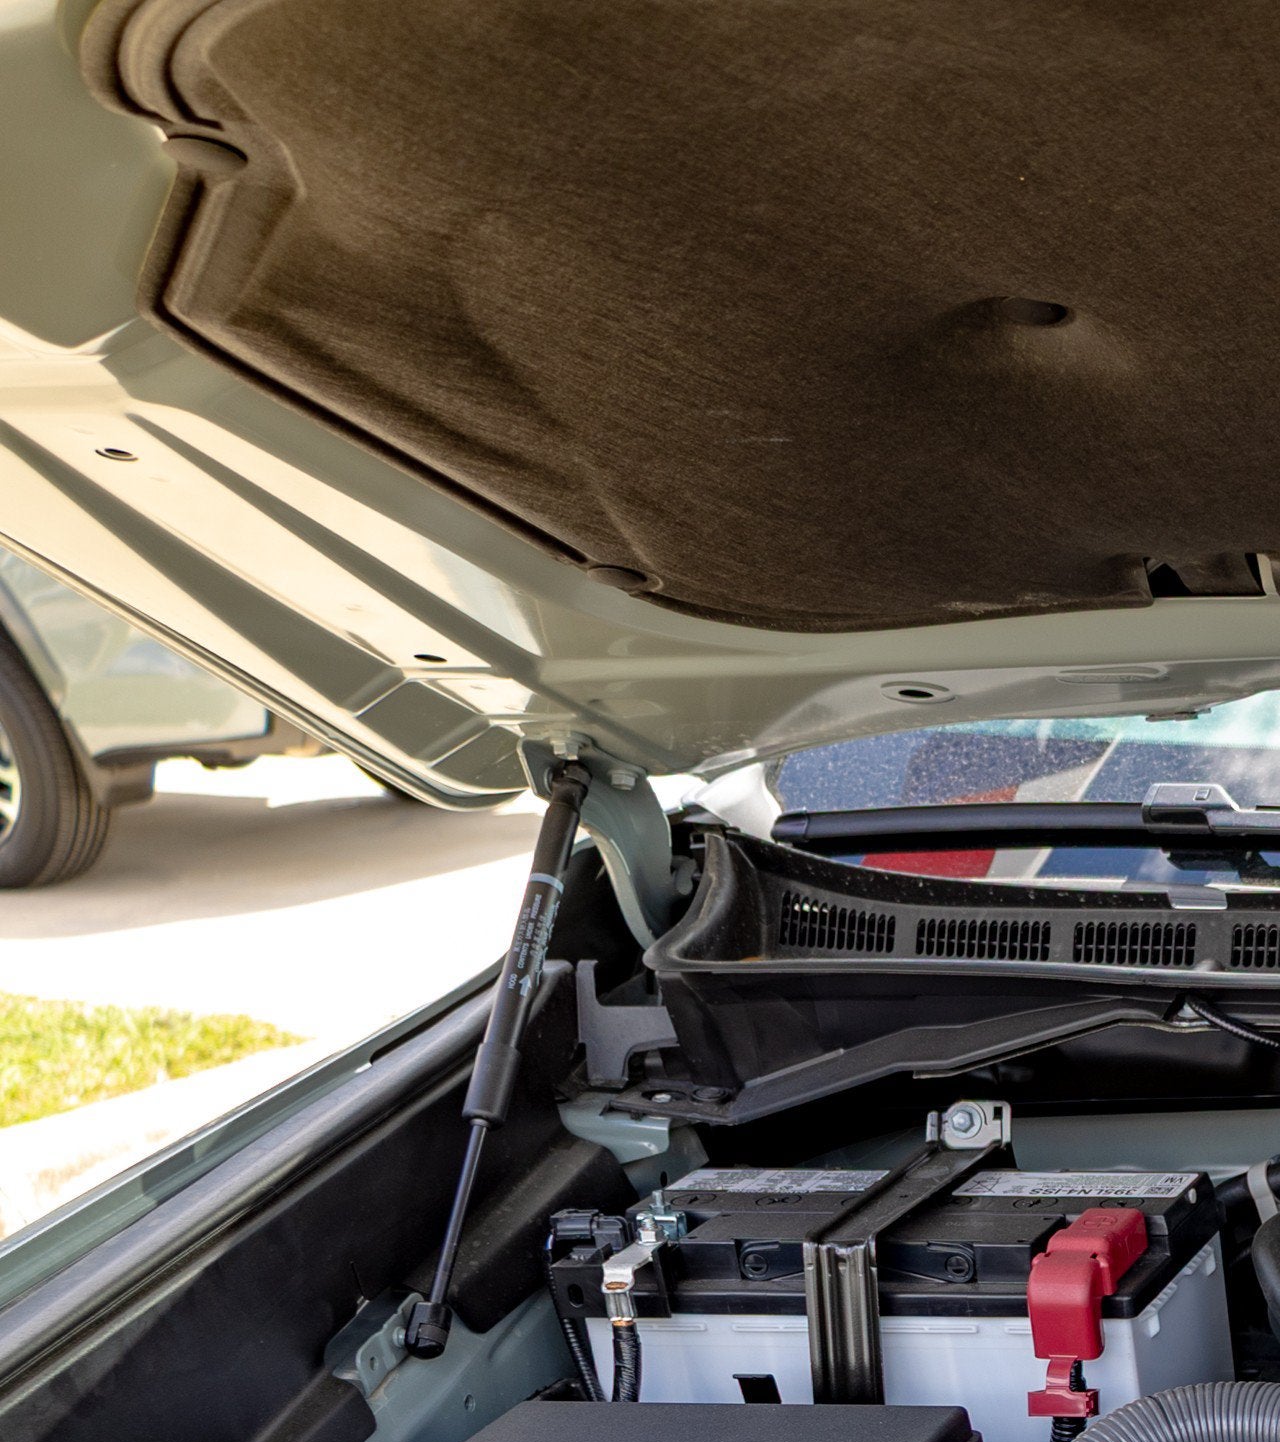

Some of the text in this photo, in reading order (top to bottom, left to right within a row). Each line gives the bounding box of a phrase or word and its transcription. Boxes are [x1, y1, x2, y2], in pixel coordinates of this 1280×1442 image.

[518, 942, 530, 969] CONTENTS
[526, 922, 535, 940] UNDER
[532, 894, 543, 919] PRESSURE
[508, 973, 518, 989] HOOD
[1028, 1187, 1138, 1197] 395LN4-ISS
